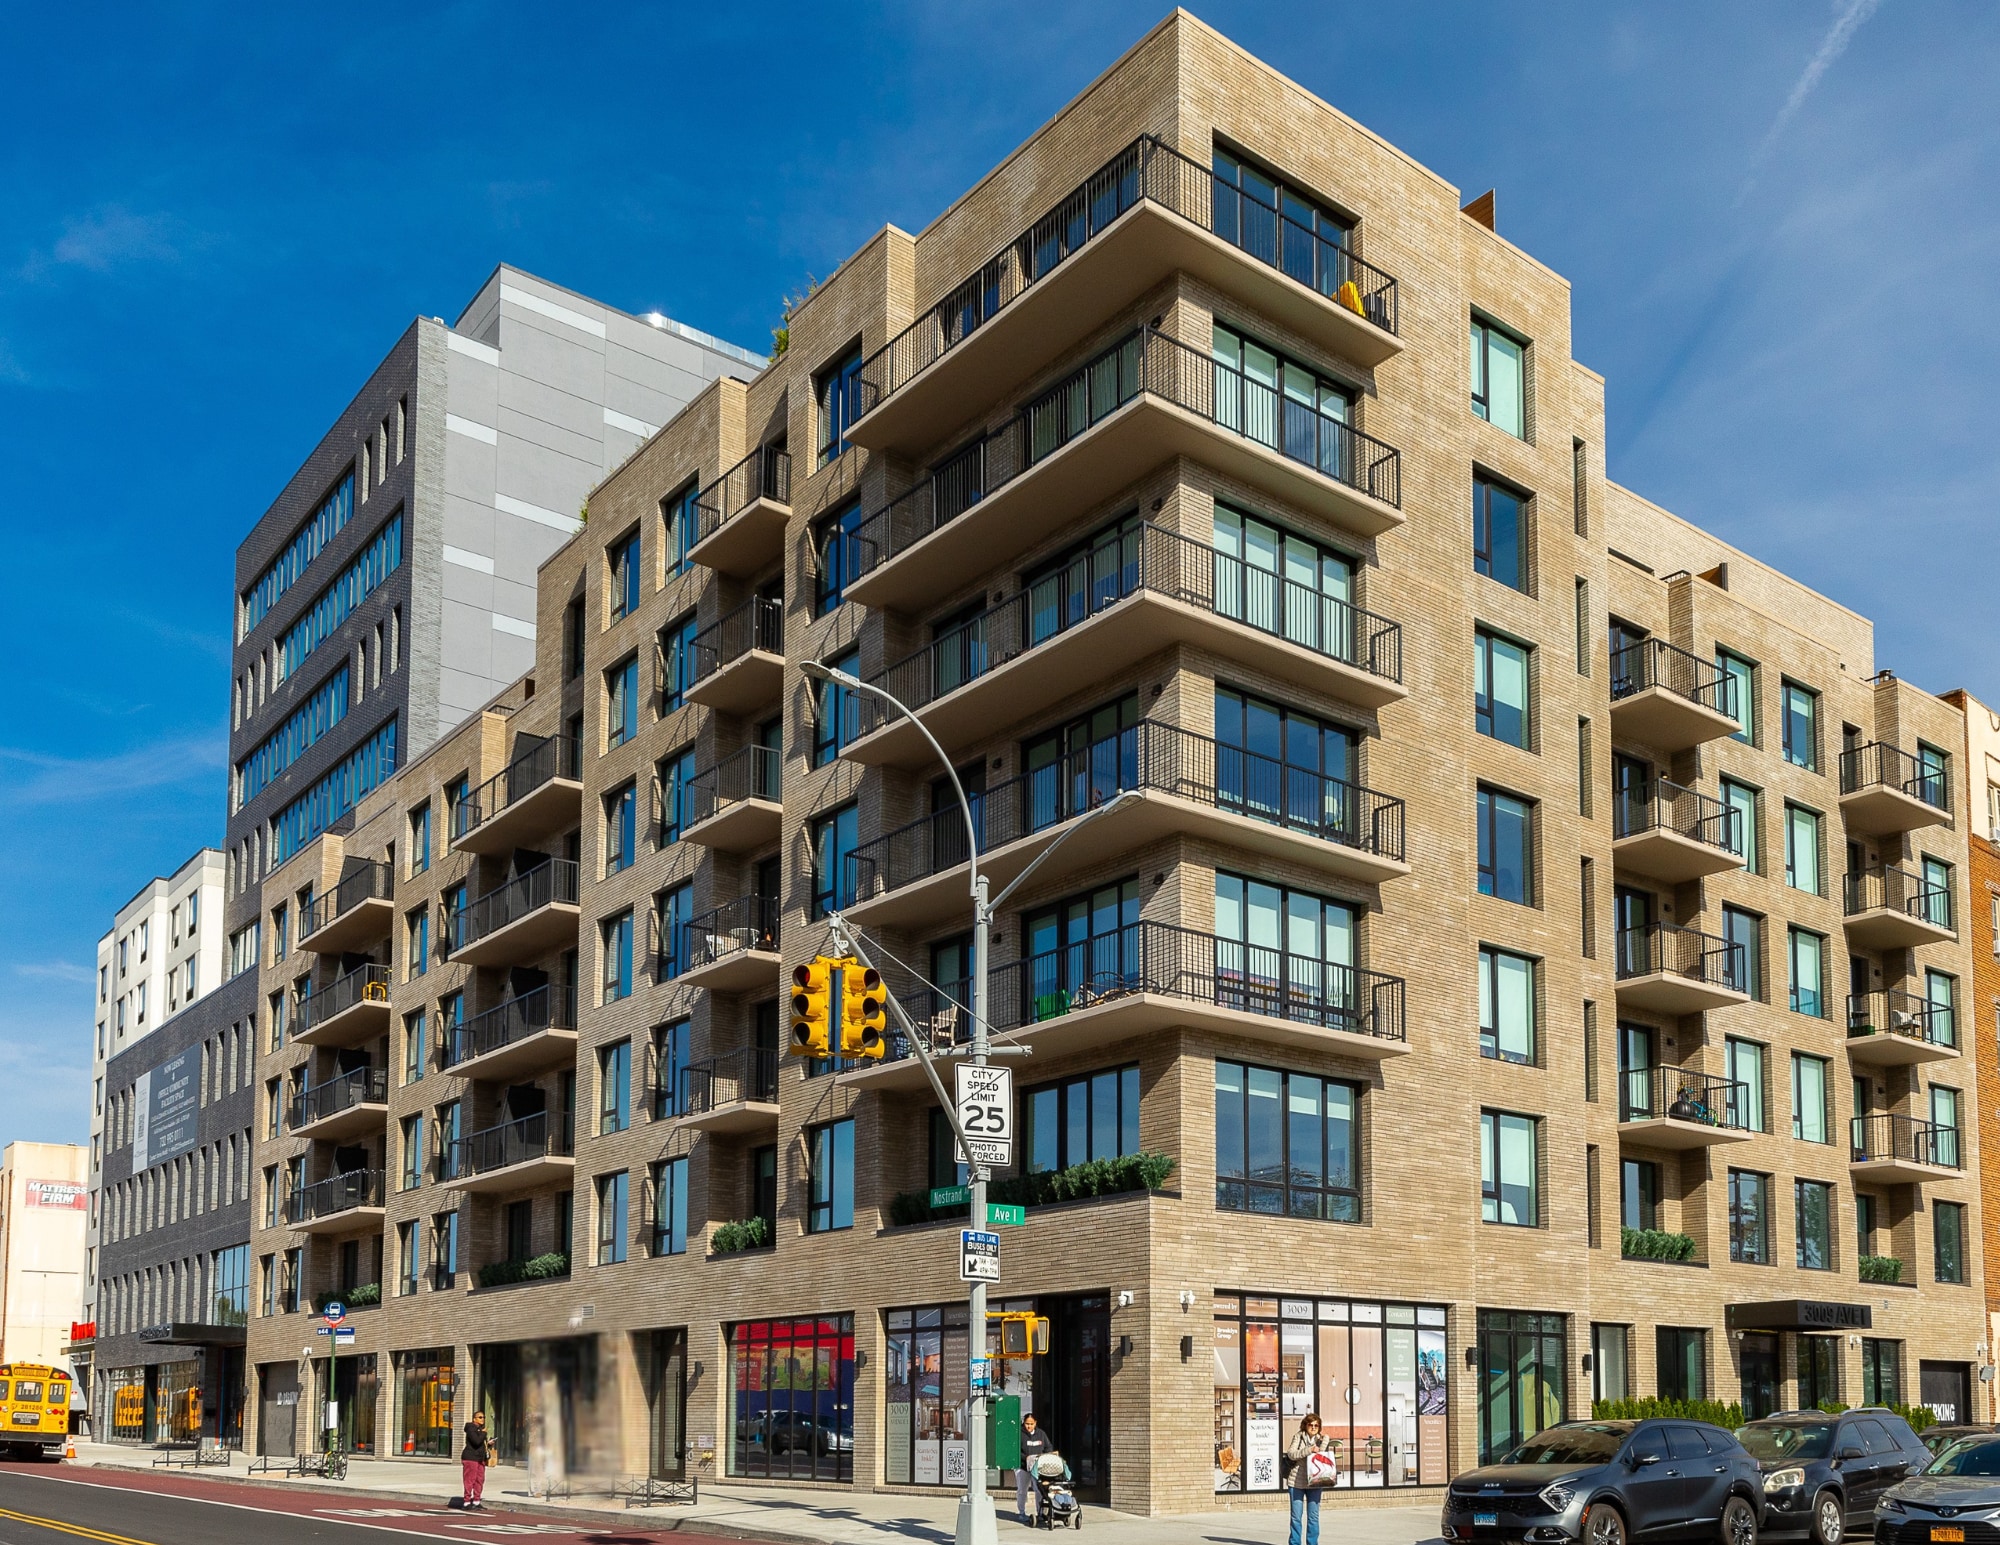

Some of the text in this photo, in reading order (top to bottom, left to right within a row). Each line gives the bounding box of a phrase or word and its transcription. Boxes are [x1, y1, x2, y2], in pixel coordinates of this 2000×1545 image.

[971, 1070, 993, 1080] CITY
[967, 1081, 999, 1091] SPEED
[971, 1093, 996, 1102] LIMIT
[964, 1105, 1005, 1133] 25
[969, 1143, 997, 1152] PHOTO
[961, 1151, 1005, 1161] EFORCED
[28, 1182, 87, 1195] MATTRESS
[41, 1192, 76, 1204] FIRM
[933, 1190, 962, 1205] Nostrand
[994, 1207, 1017, 1222] Ave I
[977, 1234, 997, 1244] BUS LANE
[967, 1241, 997, 1252] BUSES ONLY
[1287, 1304, 1308, 1314] 3009
[1804, 1304, 1833, 1323] 3009
[1834, 1306, 1860, 1325] AVE
[1216, 1327, 1238, 1335] Brooklyn
[890, 1404, 909, 1415] 3009
